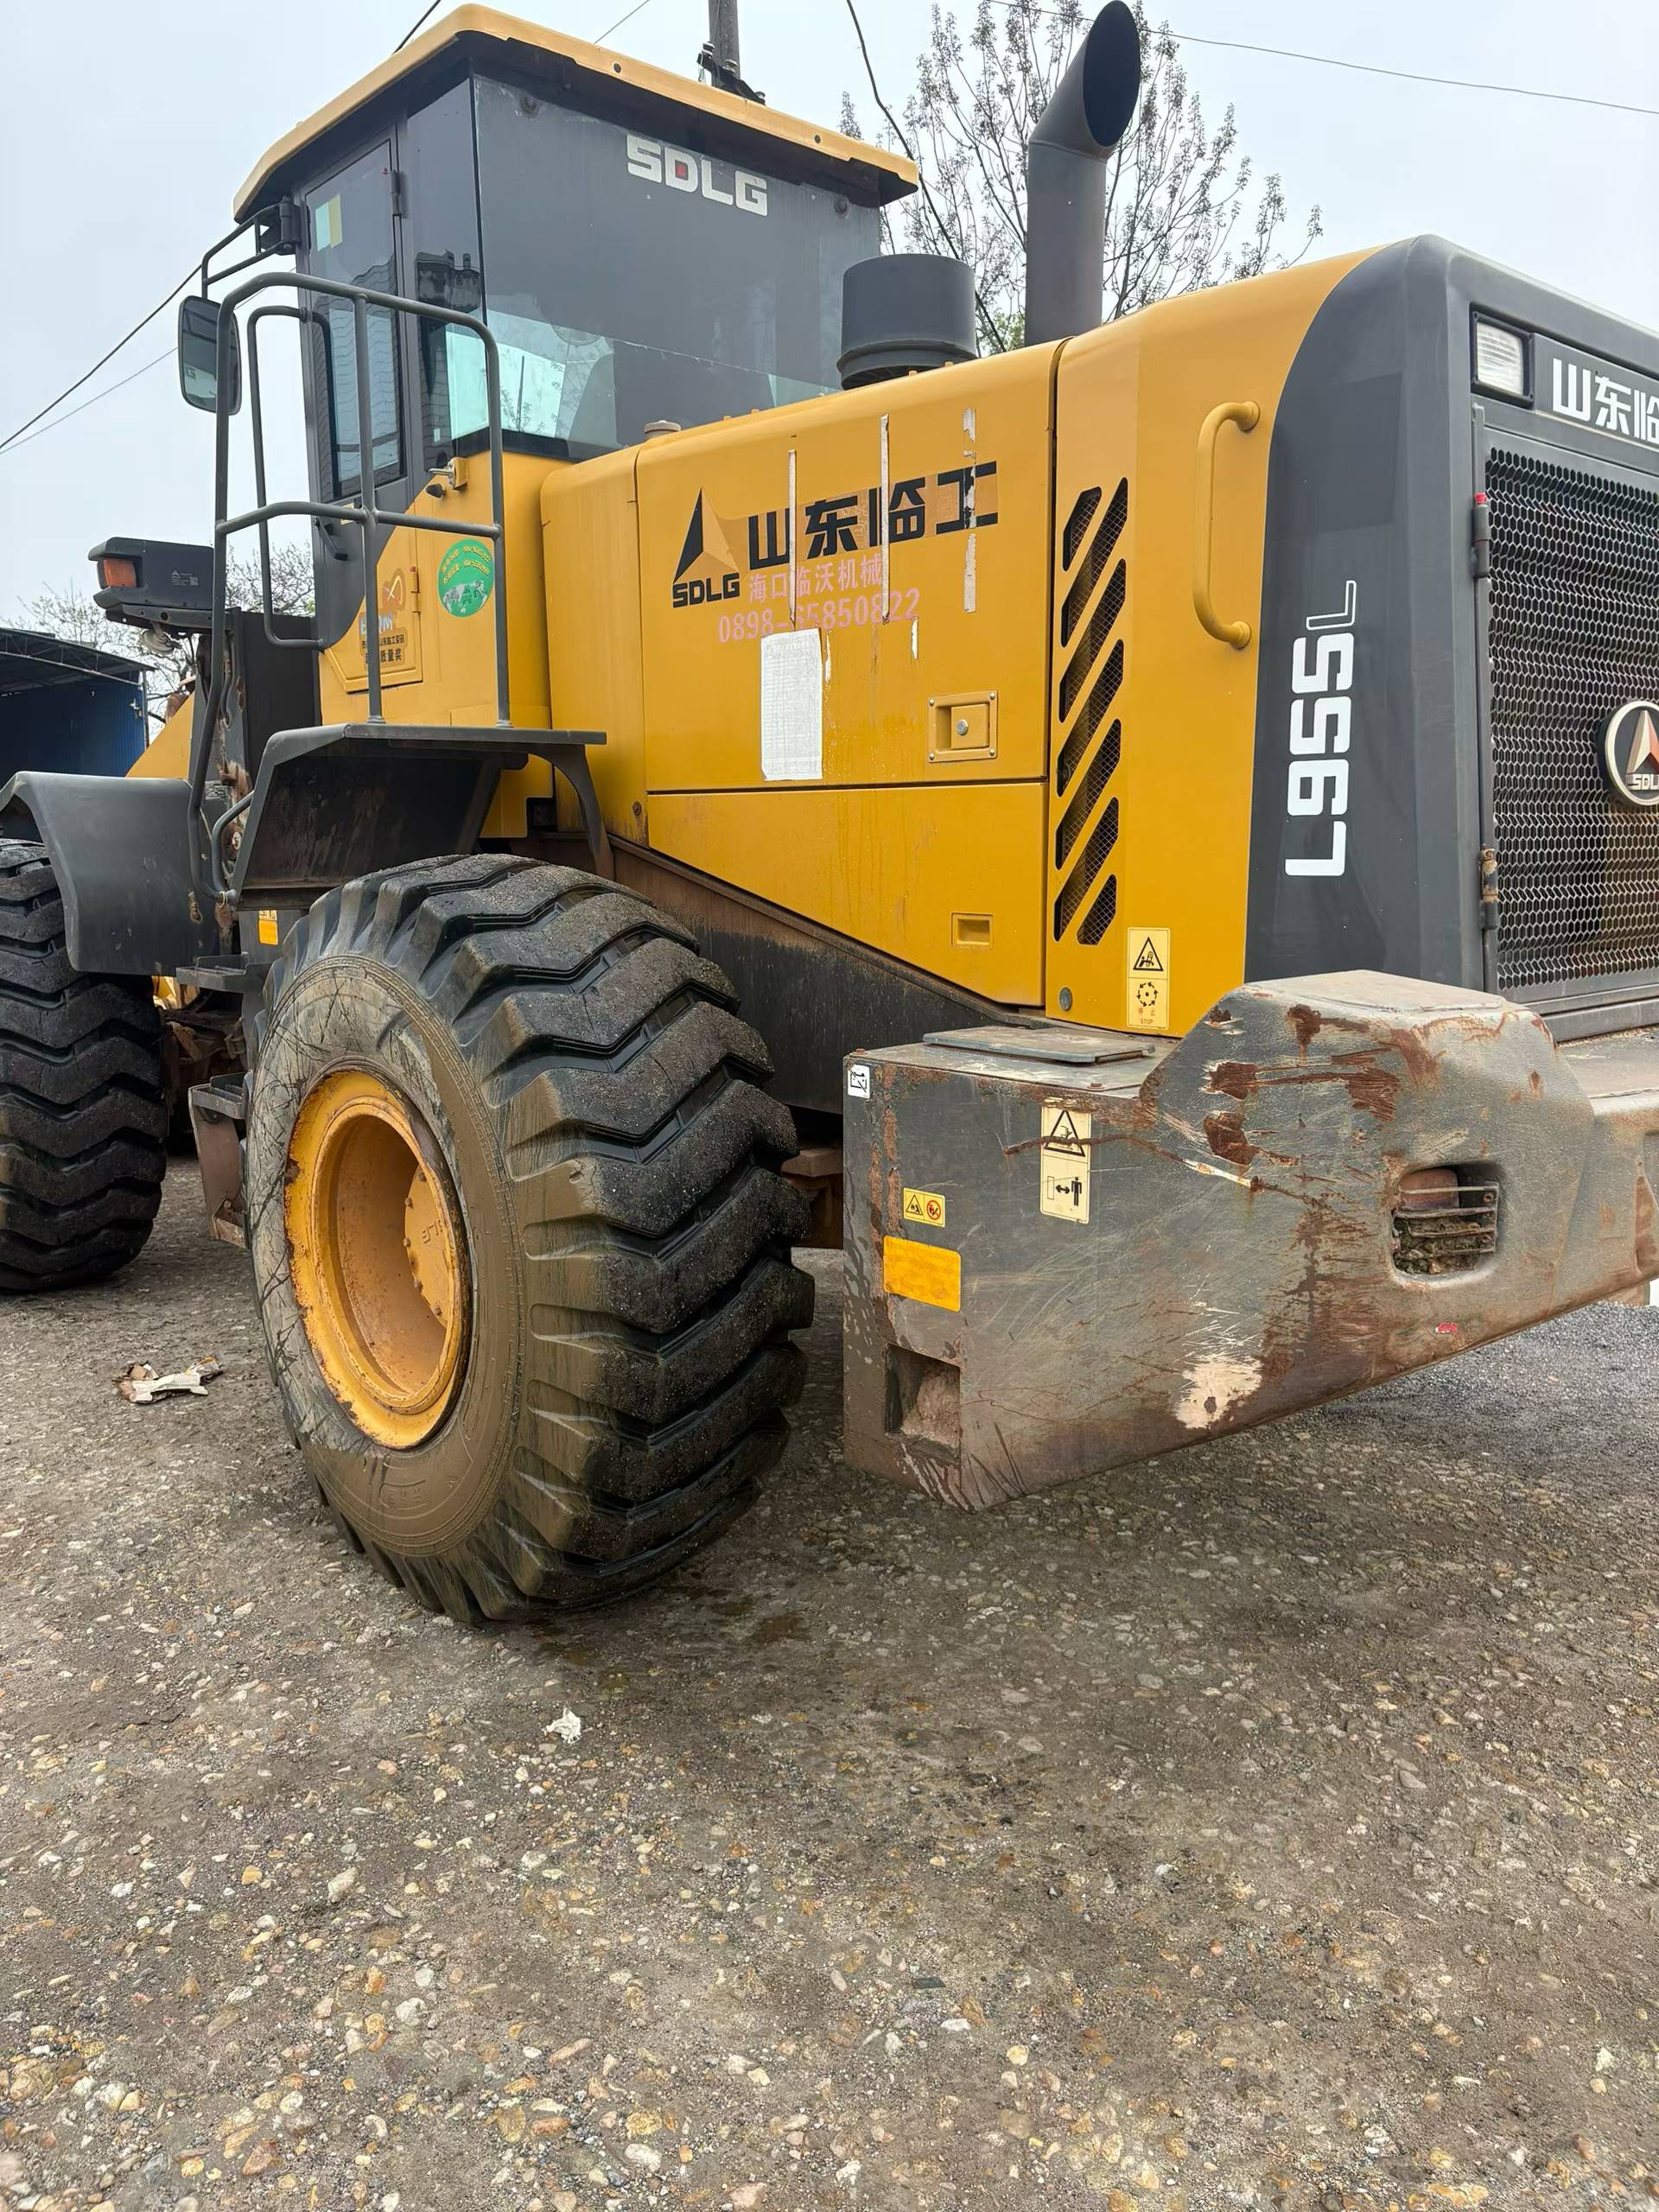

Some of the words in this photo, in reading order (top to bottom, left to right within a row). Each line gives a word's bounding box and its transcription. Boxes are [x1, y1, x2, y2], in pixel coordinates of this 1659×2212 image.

[626, 134, 767, 216] SDLG
[747, 461, 998, 570] 山东临工
[672, 572, 740, 608] SDLG
[1285, 580, 1357, 876] L955L
